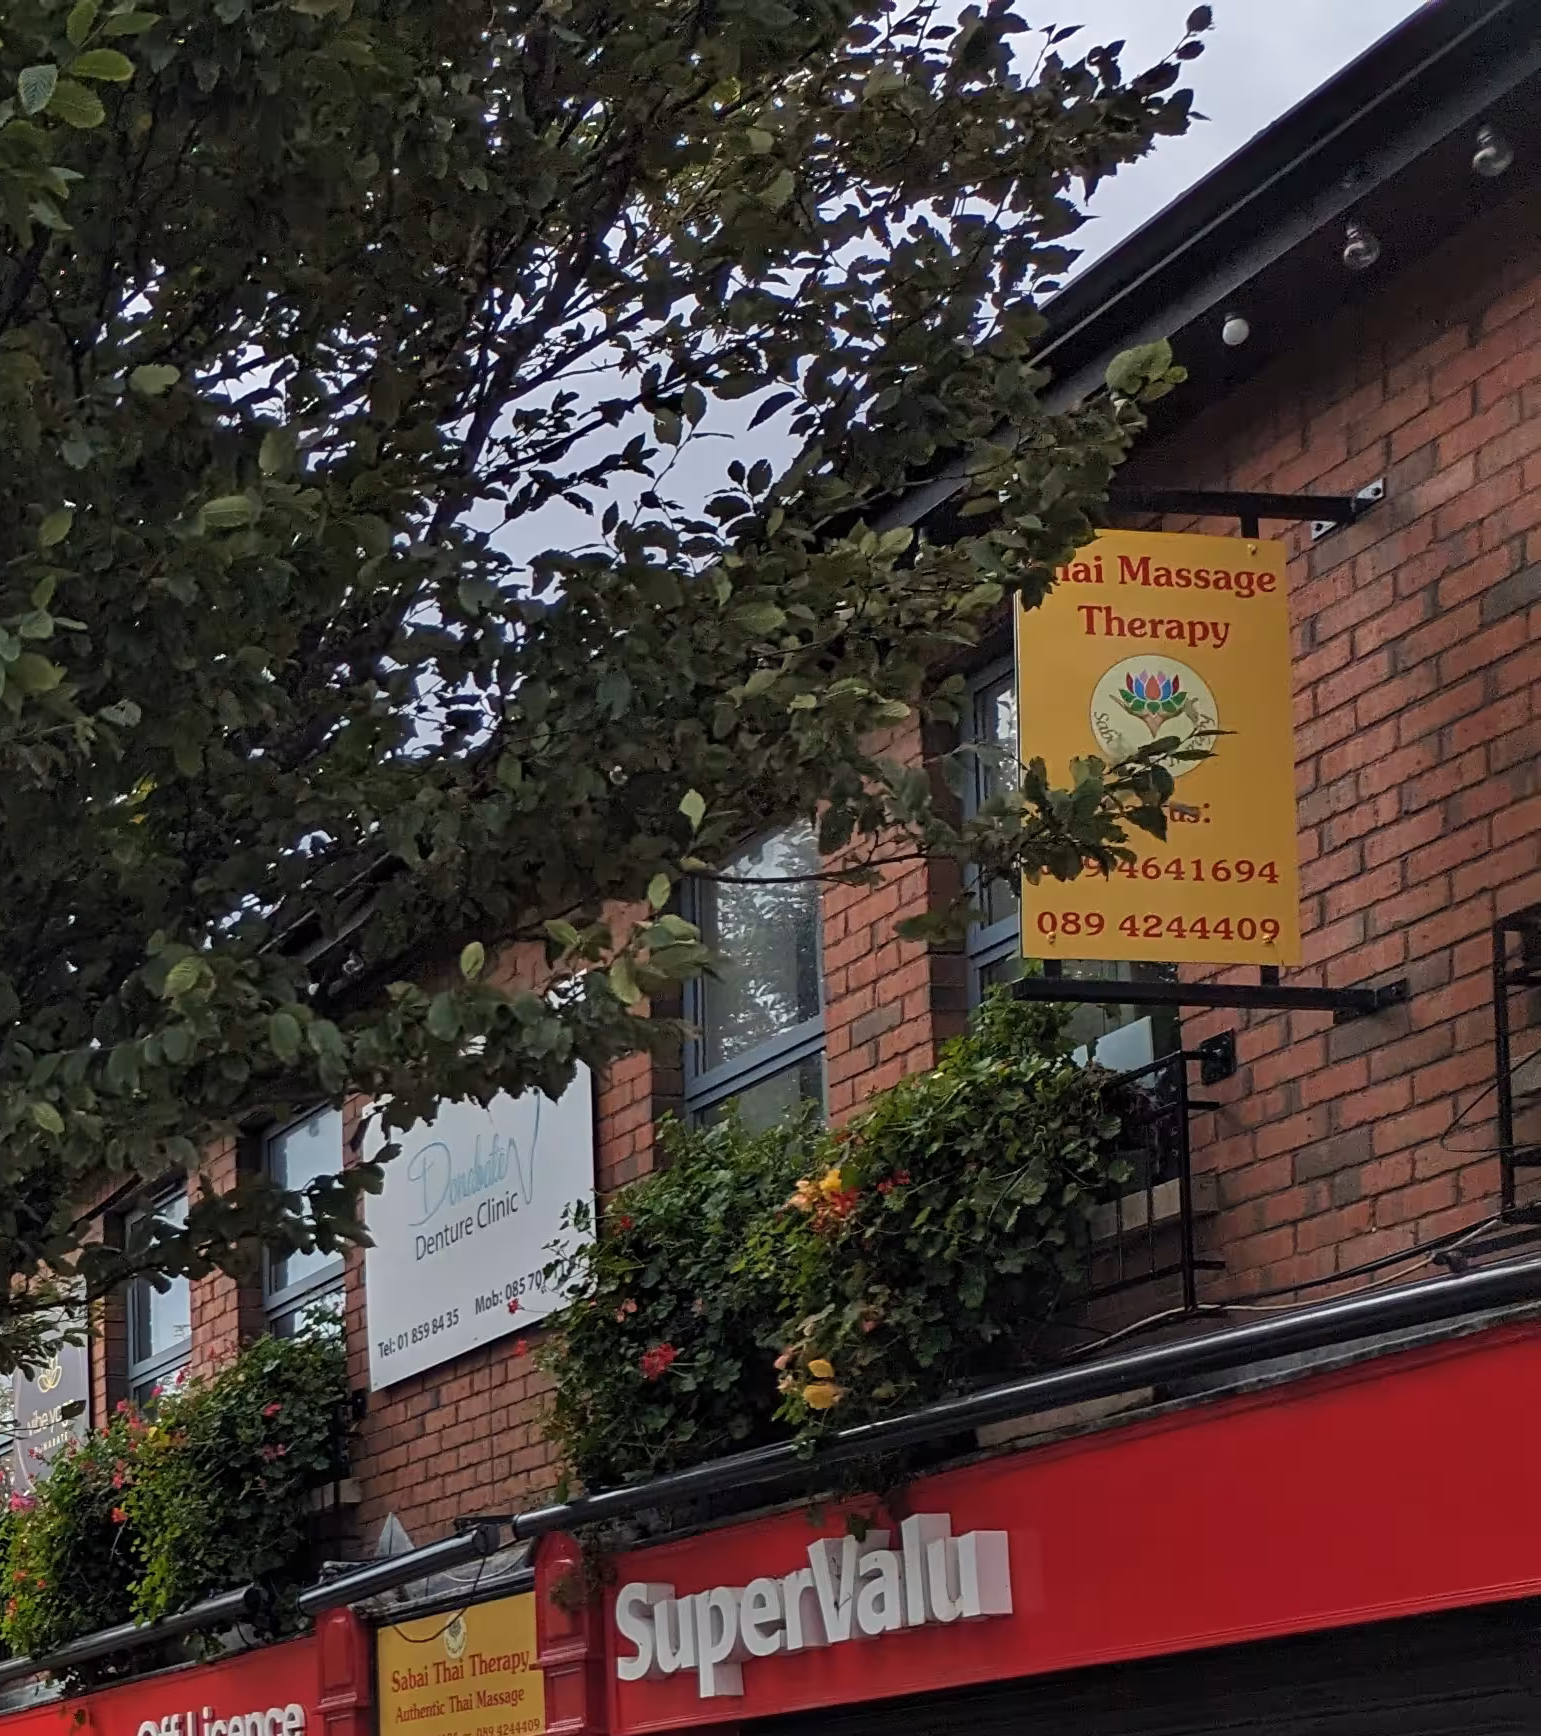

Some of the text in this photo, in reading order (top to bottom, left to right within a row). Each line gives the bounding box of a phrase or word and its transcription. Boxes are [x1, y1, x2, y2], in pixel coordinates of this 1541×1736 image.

[1117, 555, 1277, 599] Massage
[1077, 604, 1232, 649] Therapy
[1117, 856, 1280, 885] 4641694
[1037, 911, 1281, 942] 089 4244409
[415, 1190, 519, 1261] Denture Clinic
[377, 1338, 396, 1359] Tel:
[397, 1331, 409, 1351] 01
[411, 1324, 430, 1345] 859
[431, 1313, 445, 1335] 84
[446, 1308, 460, 1329] 35
[474, 1291, 503, 1315] Mob:
[615, 1512, 1014, 1699] SuperValu
[390, 1650, 530, 1693] Sabai Thai Therapy
[395, 1687, 525, 1724] Authentic Thai Massage
